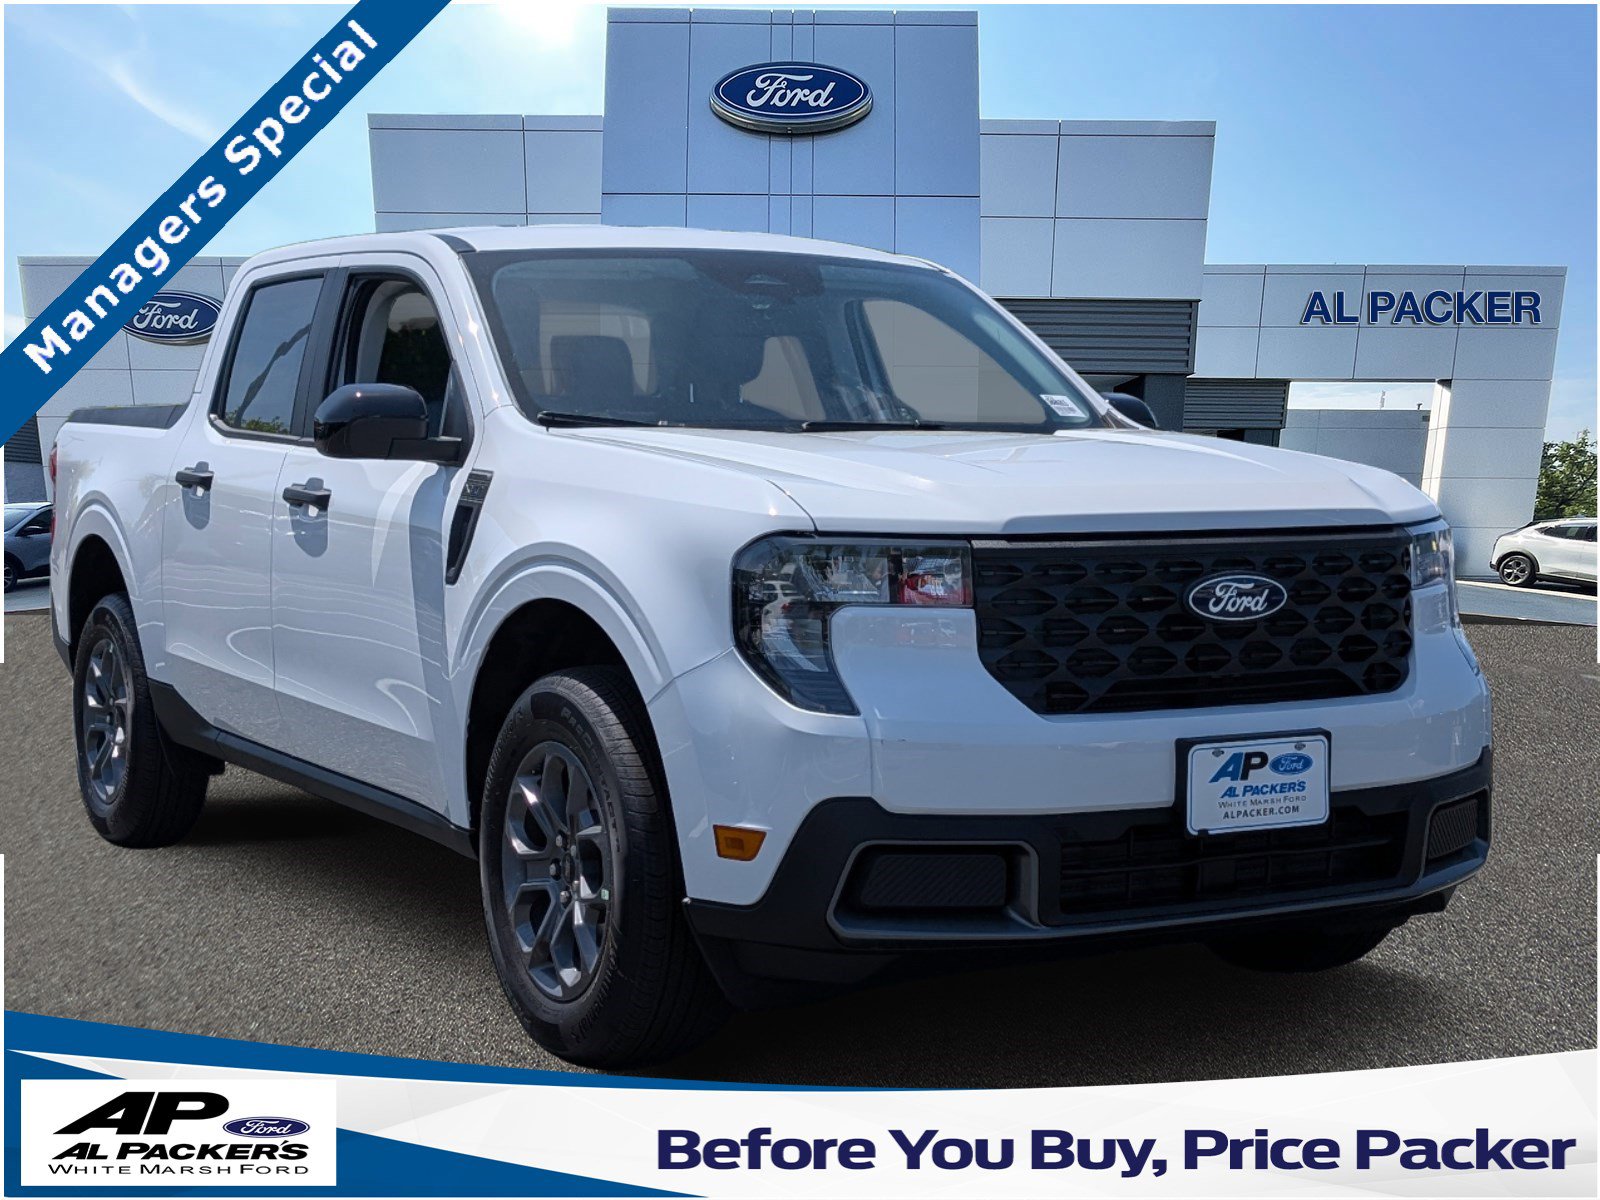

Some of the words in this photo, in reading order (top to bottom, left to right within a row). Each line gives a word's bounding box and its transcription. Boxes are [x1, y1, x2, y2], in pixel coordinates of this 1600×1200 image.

[746, 73, 836, 107] Ford
[133, 301, 199, 329] Ford
[1302, 290, 1359, 324] AL
[1369, 290, 1542, 325] PACKER
[1208, 582, 1269, 613] Ford
[1208, 751, 1269, 783] AP
[1278, 756, 1304, 771] Ford
[1218, 800, 1248, 809] WHITE
[1250, 797, 1282, 806] MARSH
[1283, 795, 1307, 803] FORD
[1220, 786, 1239, 799] AL
[1241, 780, 1307, 797] PACKER'S
[1222, 805, 1300, 820] ALPACKER.COM
